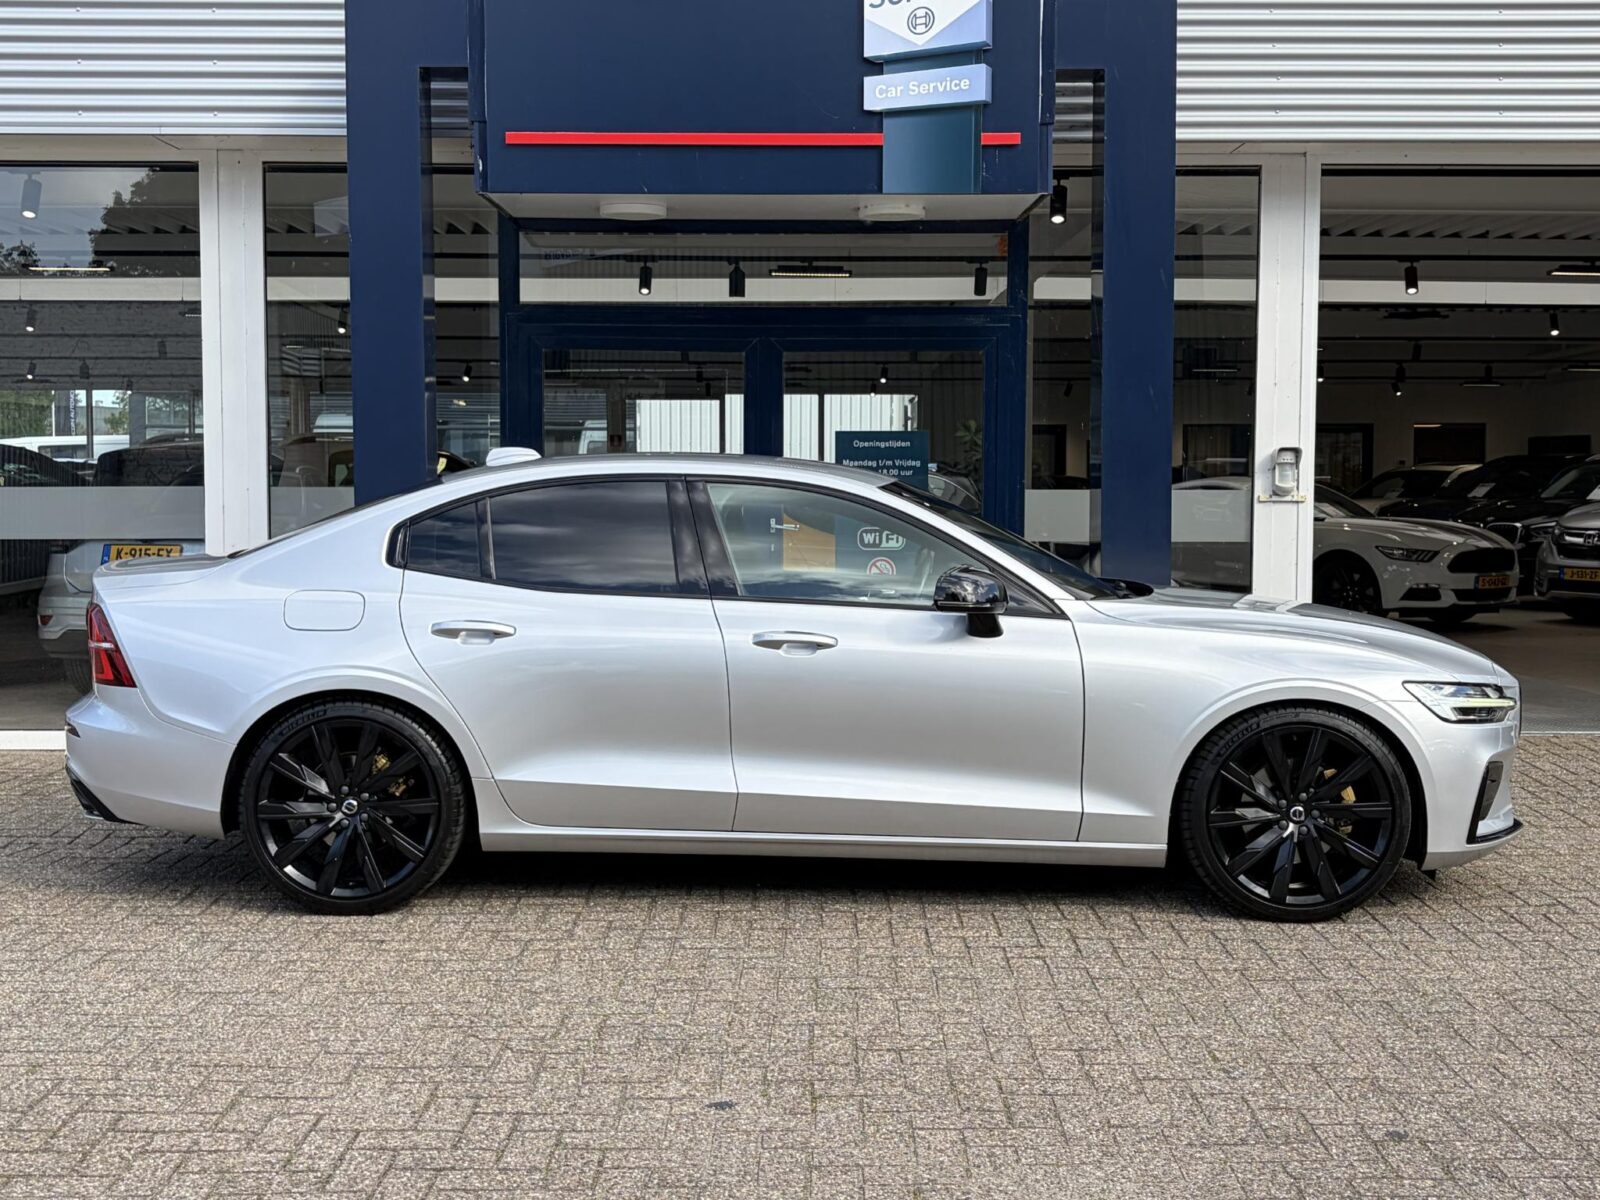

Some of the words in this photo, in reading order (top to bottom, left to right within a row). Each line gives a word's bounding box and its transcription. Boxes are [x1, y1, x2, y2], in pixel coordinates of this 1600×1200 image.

[875, 84, 904, 99] Car
[908, 77, 971, 96] Service
[853, 439, 911, 449] Openingstijden
[842, 459, 877, 468] Maandag
[878, 459, 893, 467] t/m
[894, 459, 921, 468] Vrijdag
